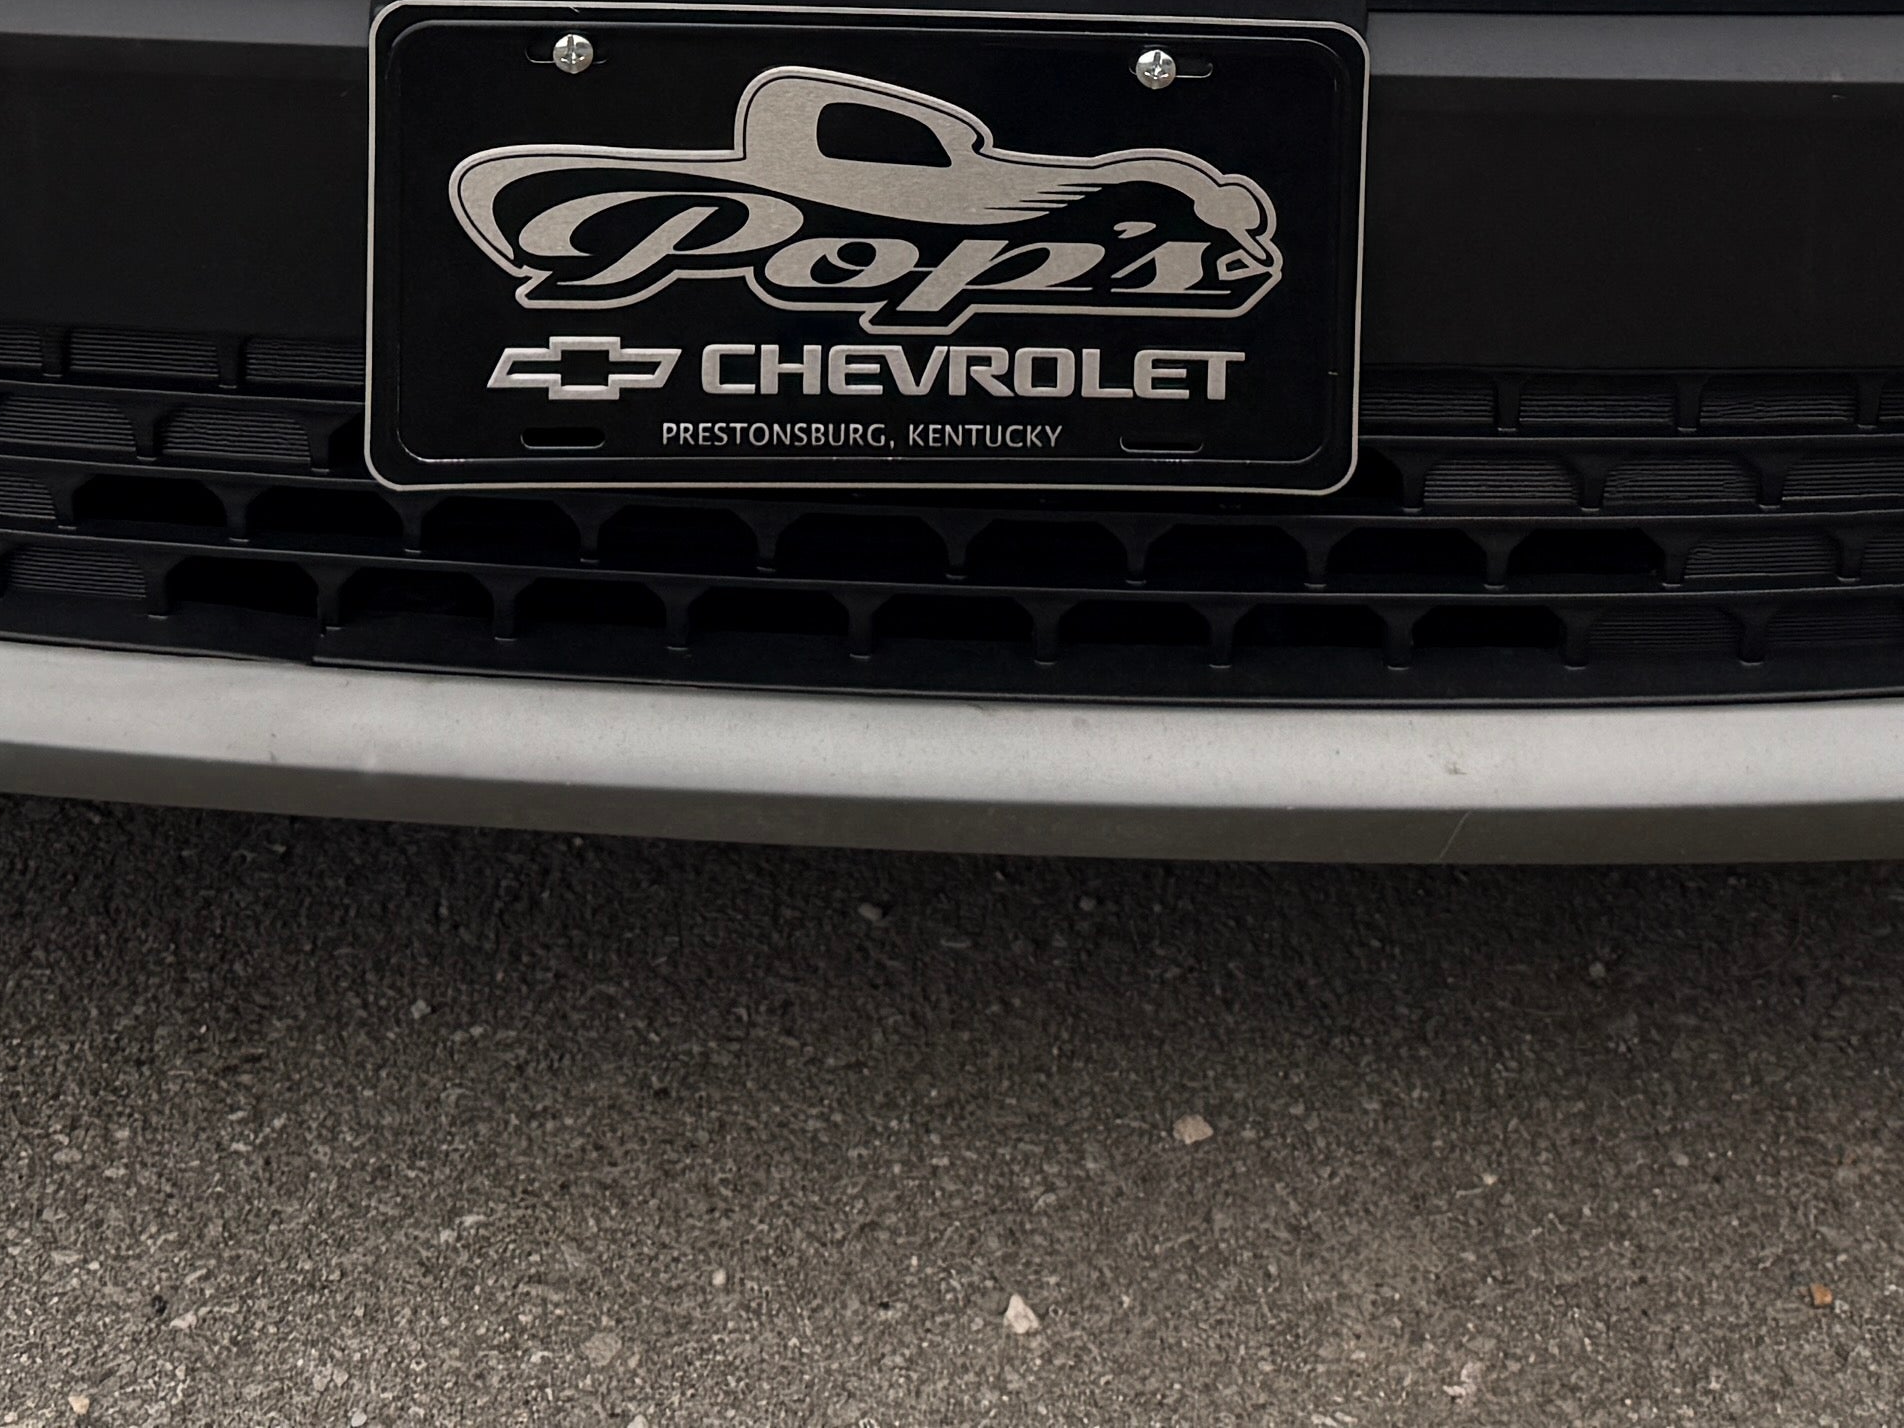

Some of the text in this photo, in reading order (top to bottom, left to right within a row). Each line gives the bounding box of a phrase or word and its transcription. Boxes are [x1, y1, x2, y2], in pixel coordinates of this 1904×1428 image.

[518, 191, 1231, 312] Pop's
[701, 344, 1246, 400] CHEVROLET
[662, 422, 1063, 449] PRESTONSBURG, KENTUCKY
